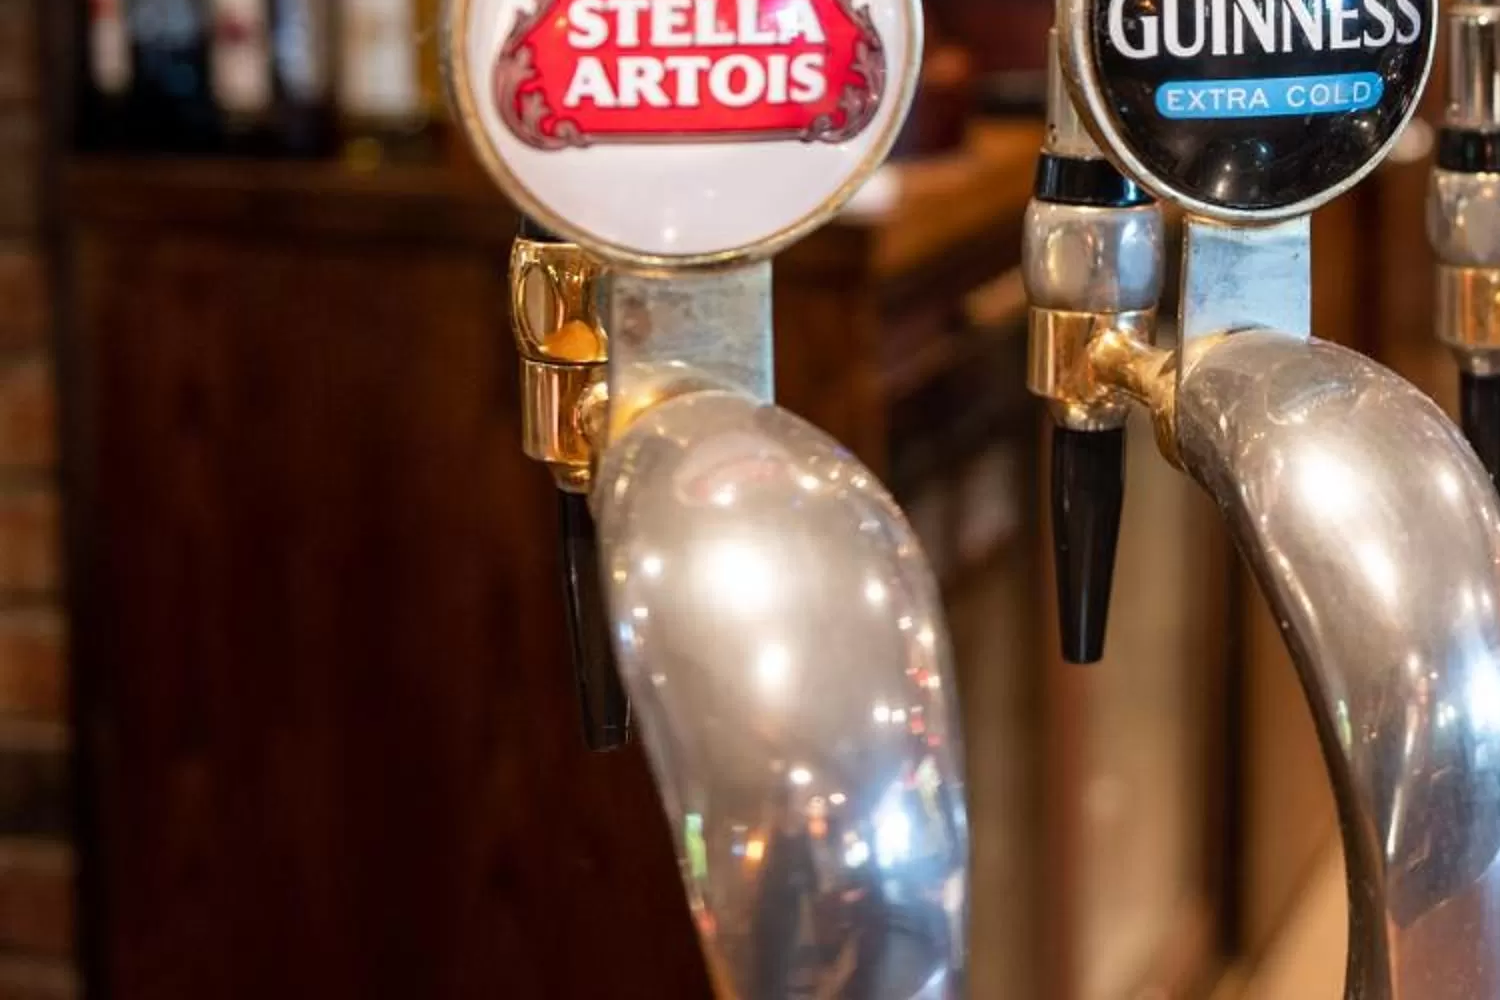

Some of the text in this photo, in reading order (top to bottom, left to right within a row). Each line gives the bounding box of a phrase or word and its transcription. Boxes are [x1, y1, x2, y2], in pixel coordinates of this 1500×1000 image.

[562, 53, 827, 107] ARTOIS
[1166, 81, 1372, 112] EXTRA COLD
